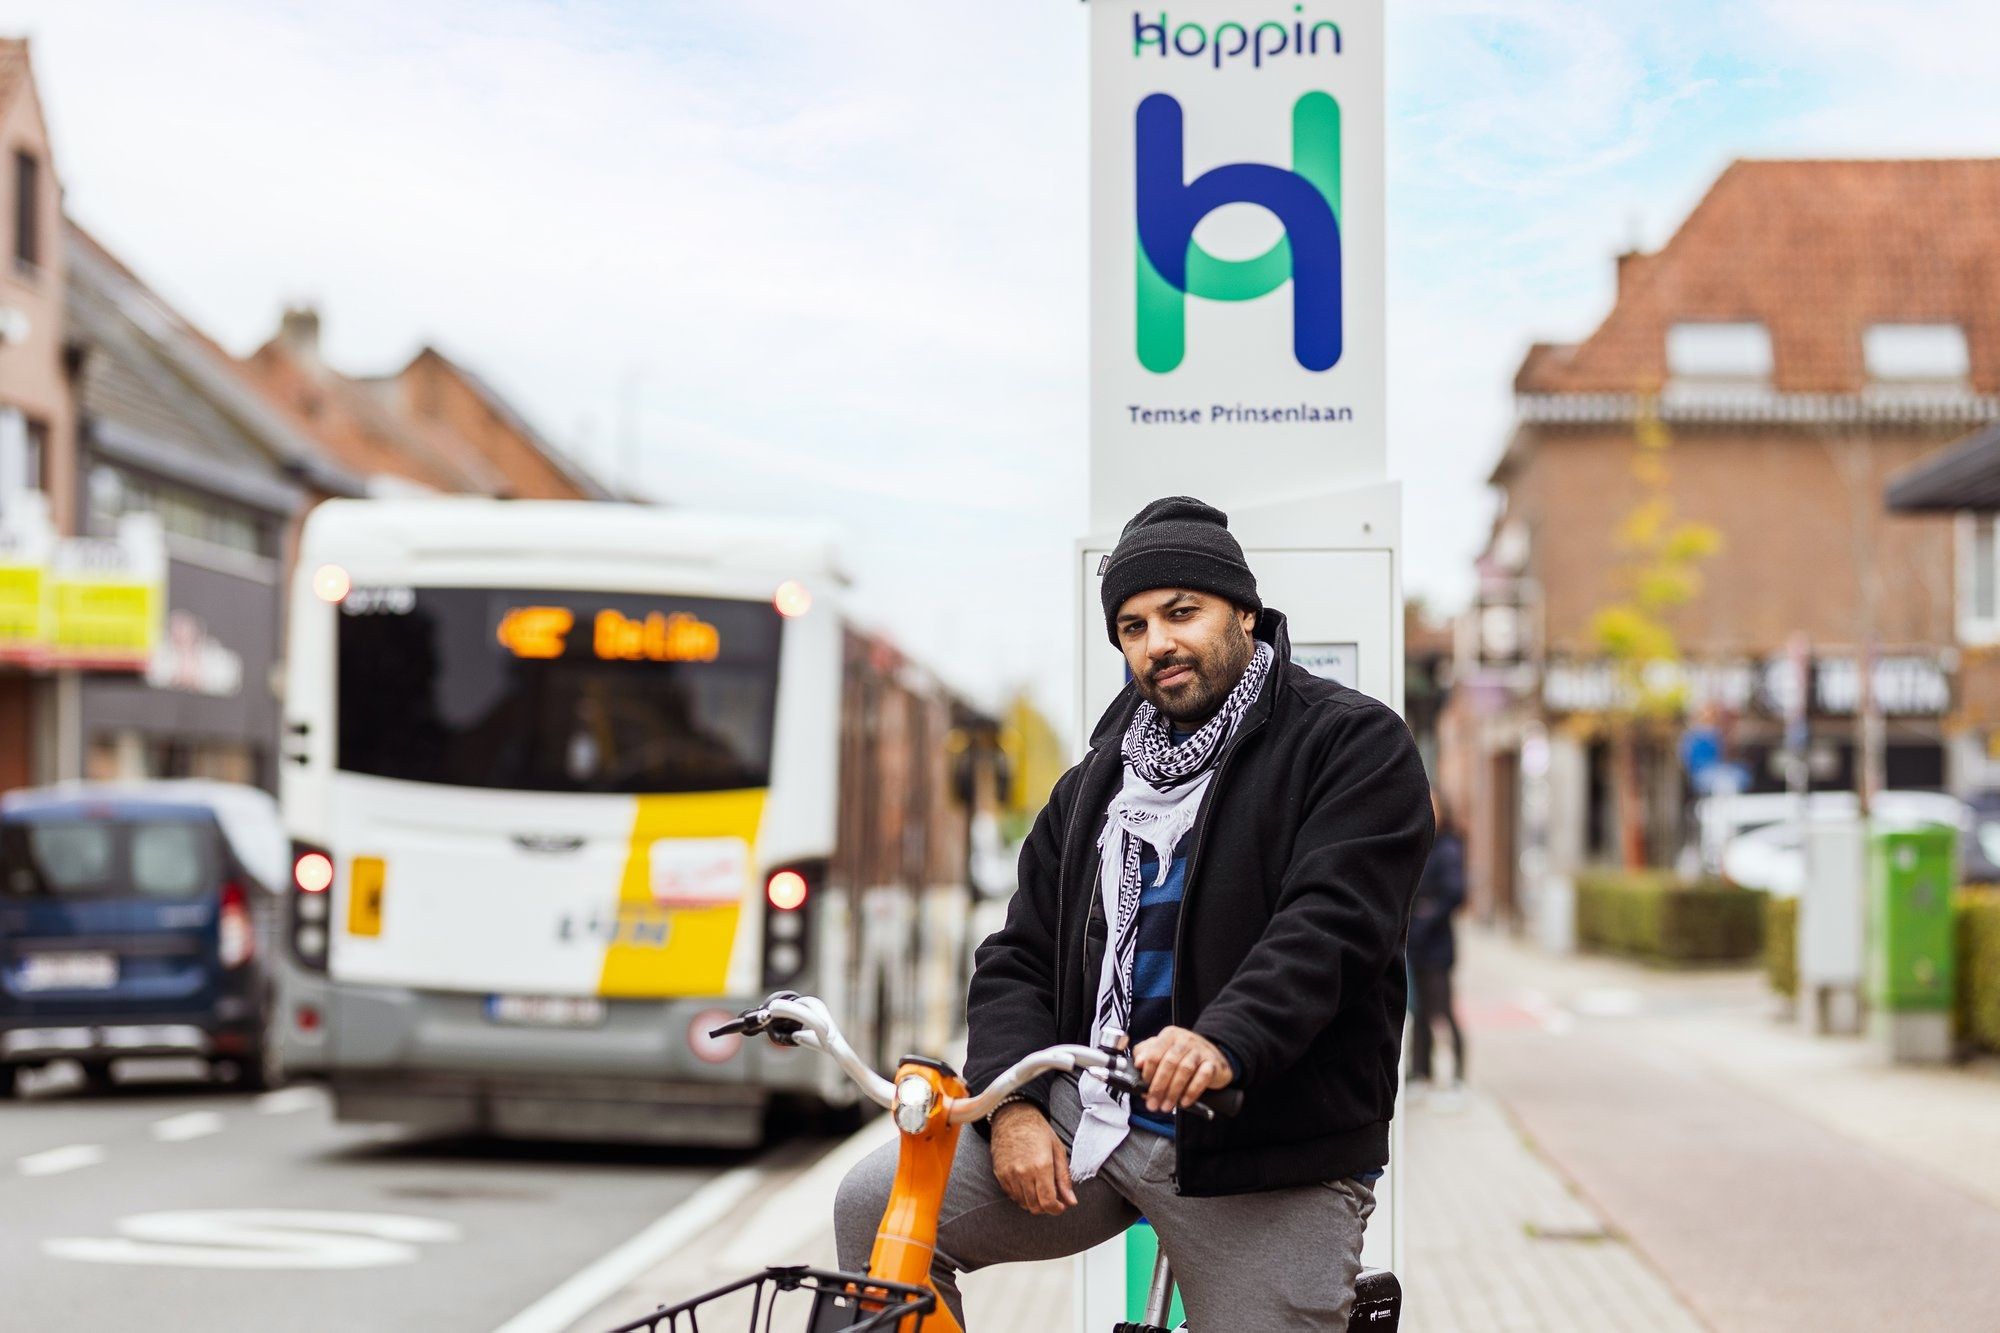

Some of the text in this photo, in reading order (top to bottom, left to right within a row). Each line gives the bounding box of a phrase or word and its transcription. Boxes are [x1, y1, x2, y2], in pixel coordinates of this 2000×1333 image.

[1133, 4, 1342, 69] Hoppin
[1128, 403, 1353, 424] Temse Prinsenlaan
